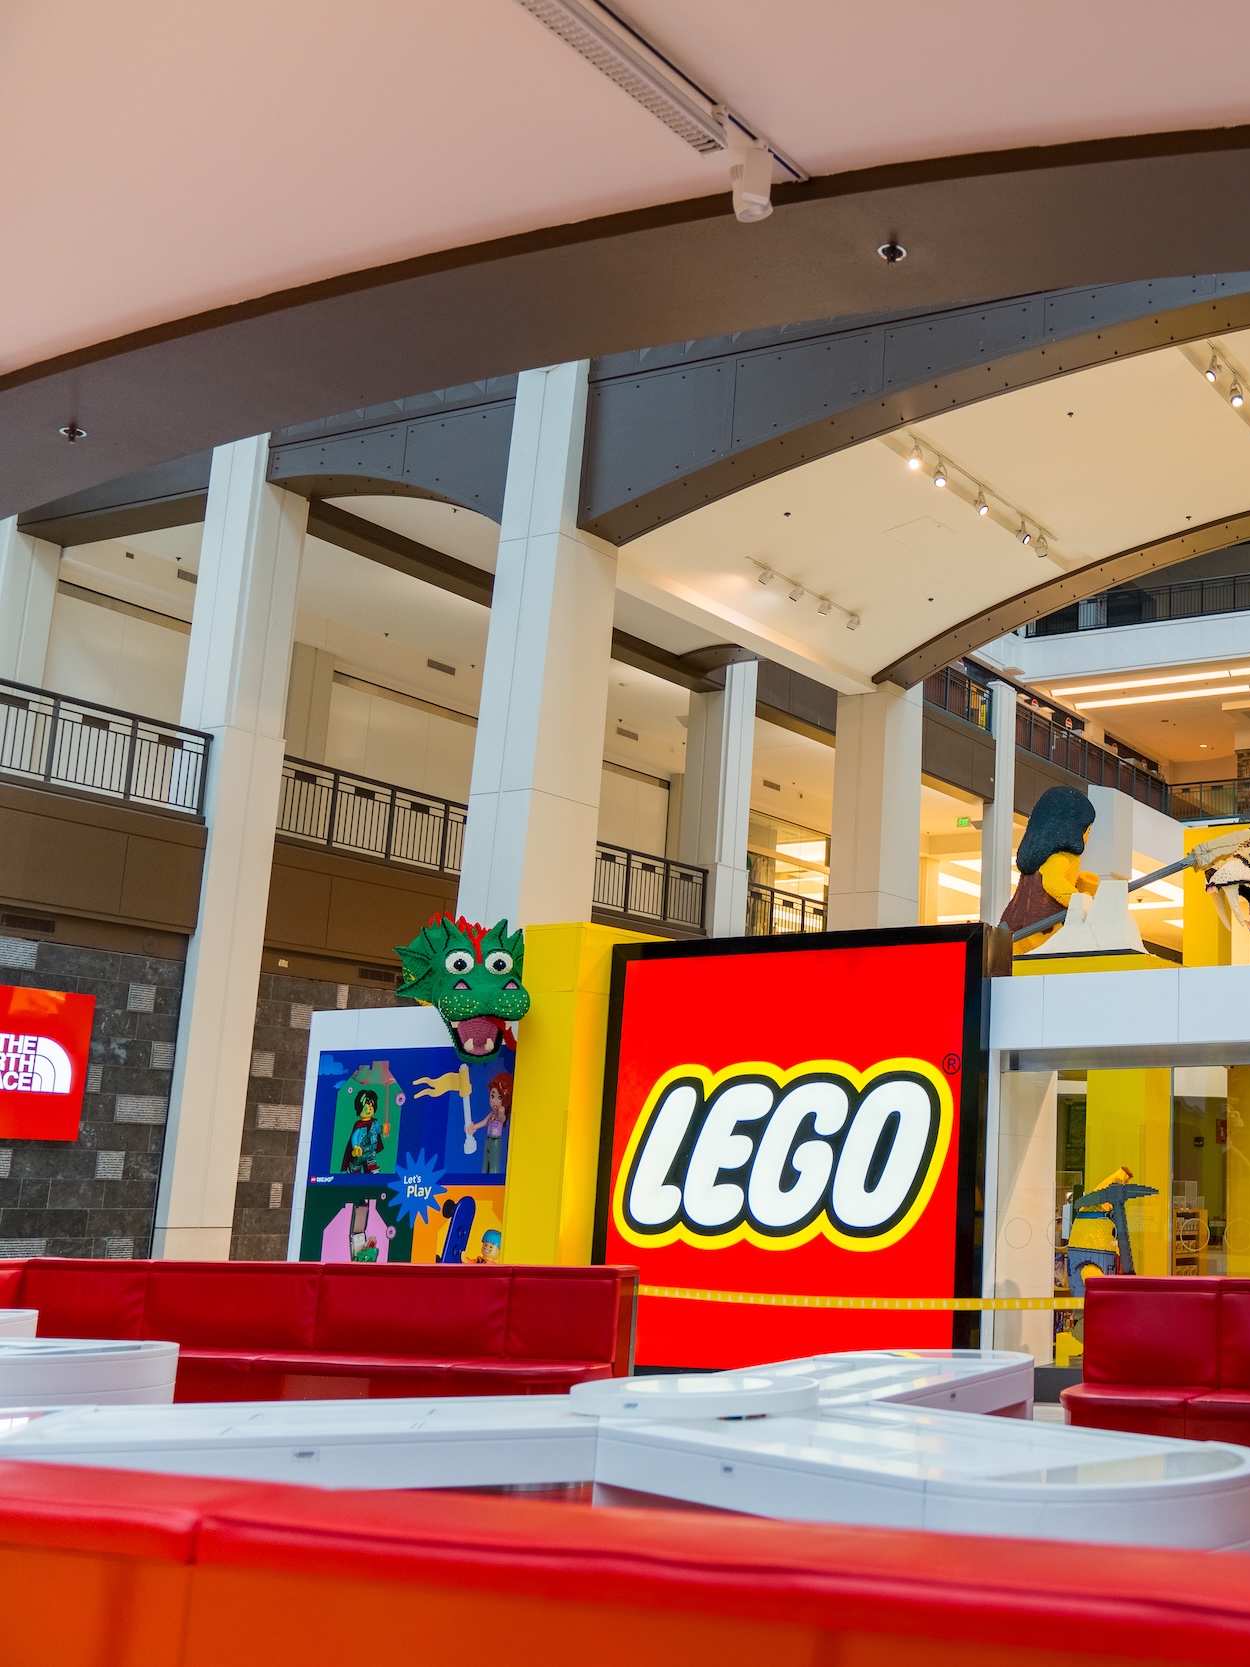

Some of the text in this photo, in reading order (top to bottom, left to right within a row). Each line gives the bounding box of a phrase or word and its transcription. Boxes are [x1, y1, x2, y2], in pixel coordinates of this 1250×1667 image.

[0, 1033, 38, 1055] THE
[0, 1071, 33, 1091] CE
[623, 1071, 941, 1238] LEGO
[404, 1174, 422, 1185] Let's
[406, 1185, 432, 1199] Play
